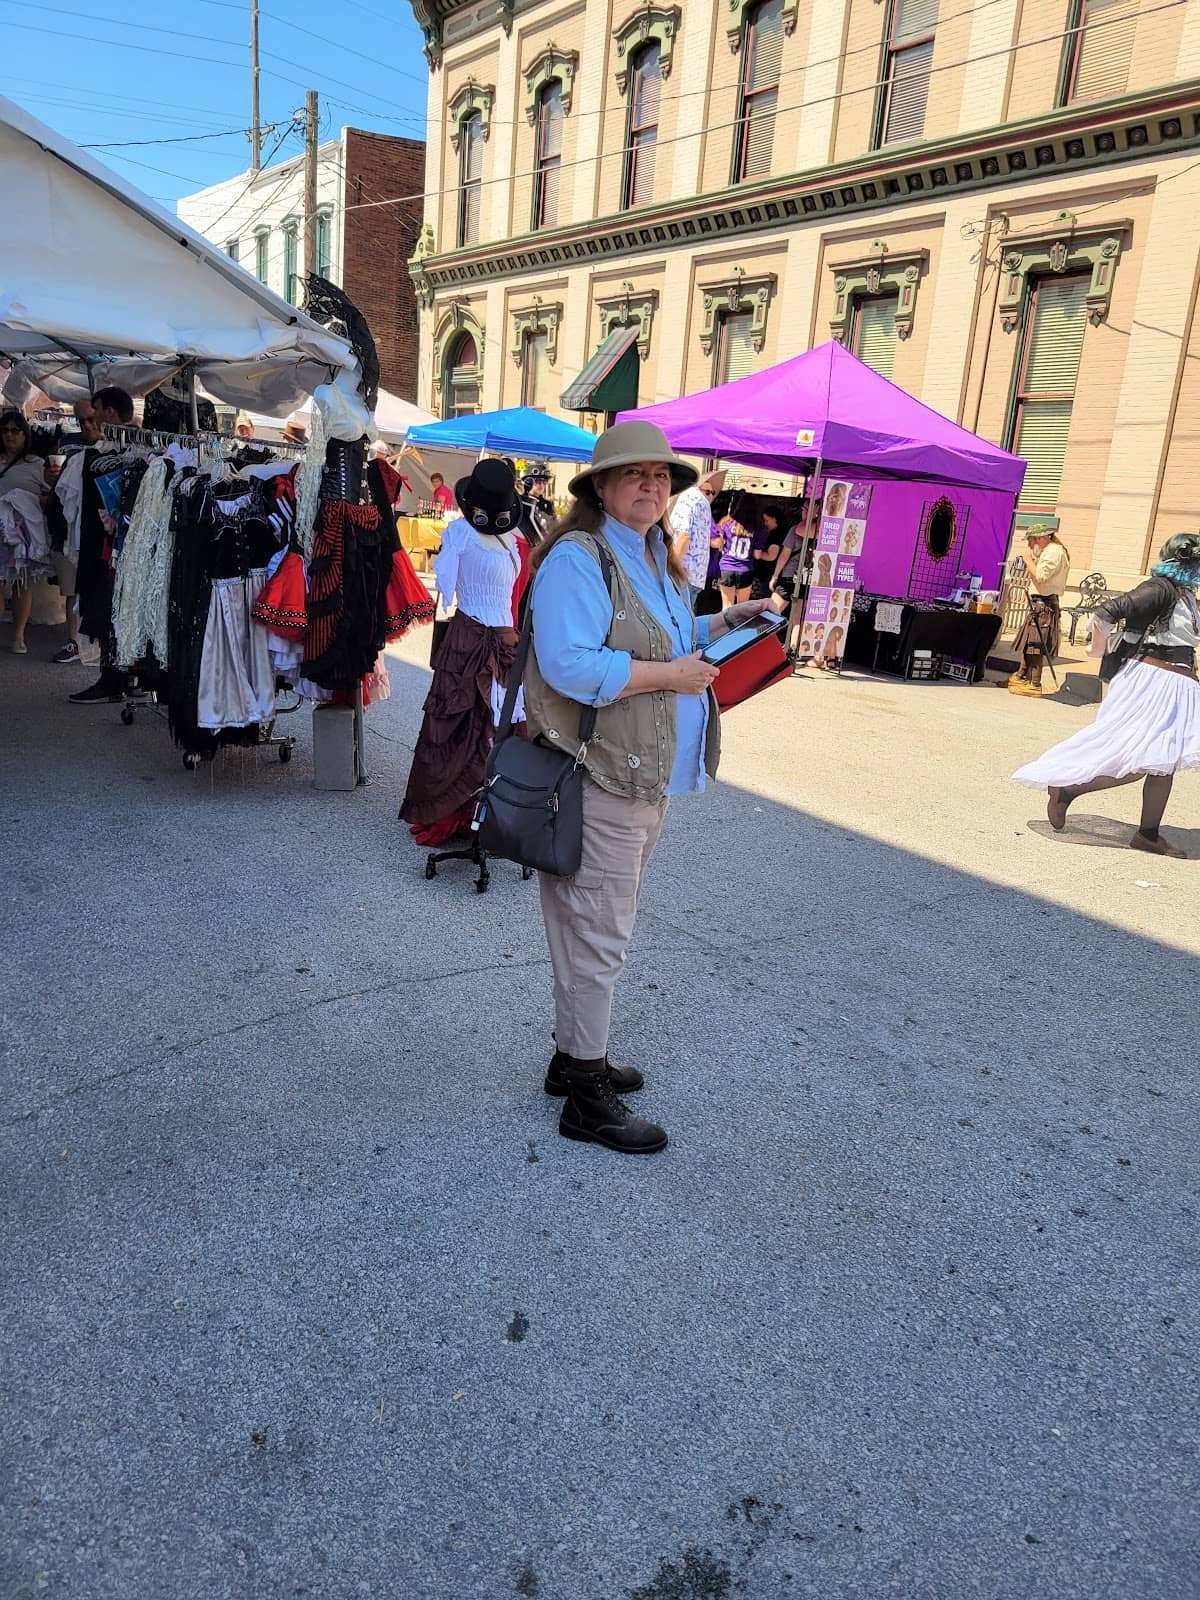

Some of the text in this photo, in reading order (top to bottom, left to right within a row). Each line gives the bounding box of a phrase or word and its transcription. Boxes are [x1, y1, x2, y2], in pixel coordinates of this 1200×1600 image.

[728, 535, 751, 559] 10
[838, 567, 855, 576] HAIR
[837, 574, 854, 582] TYPES
